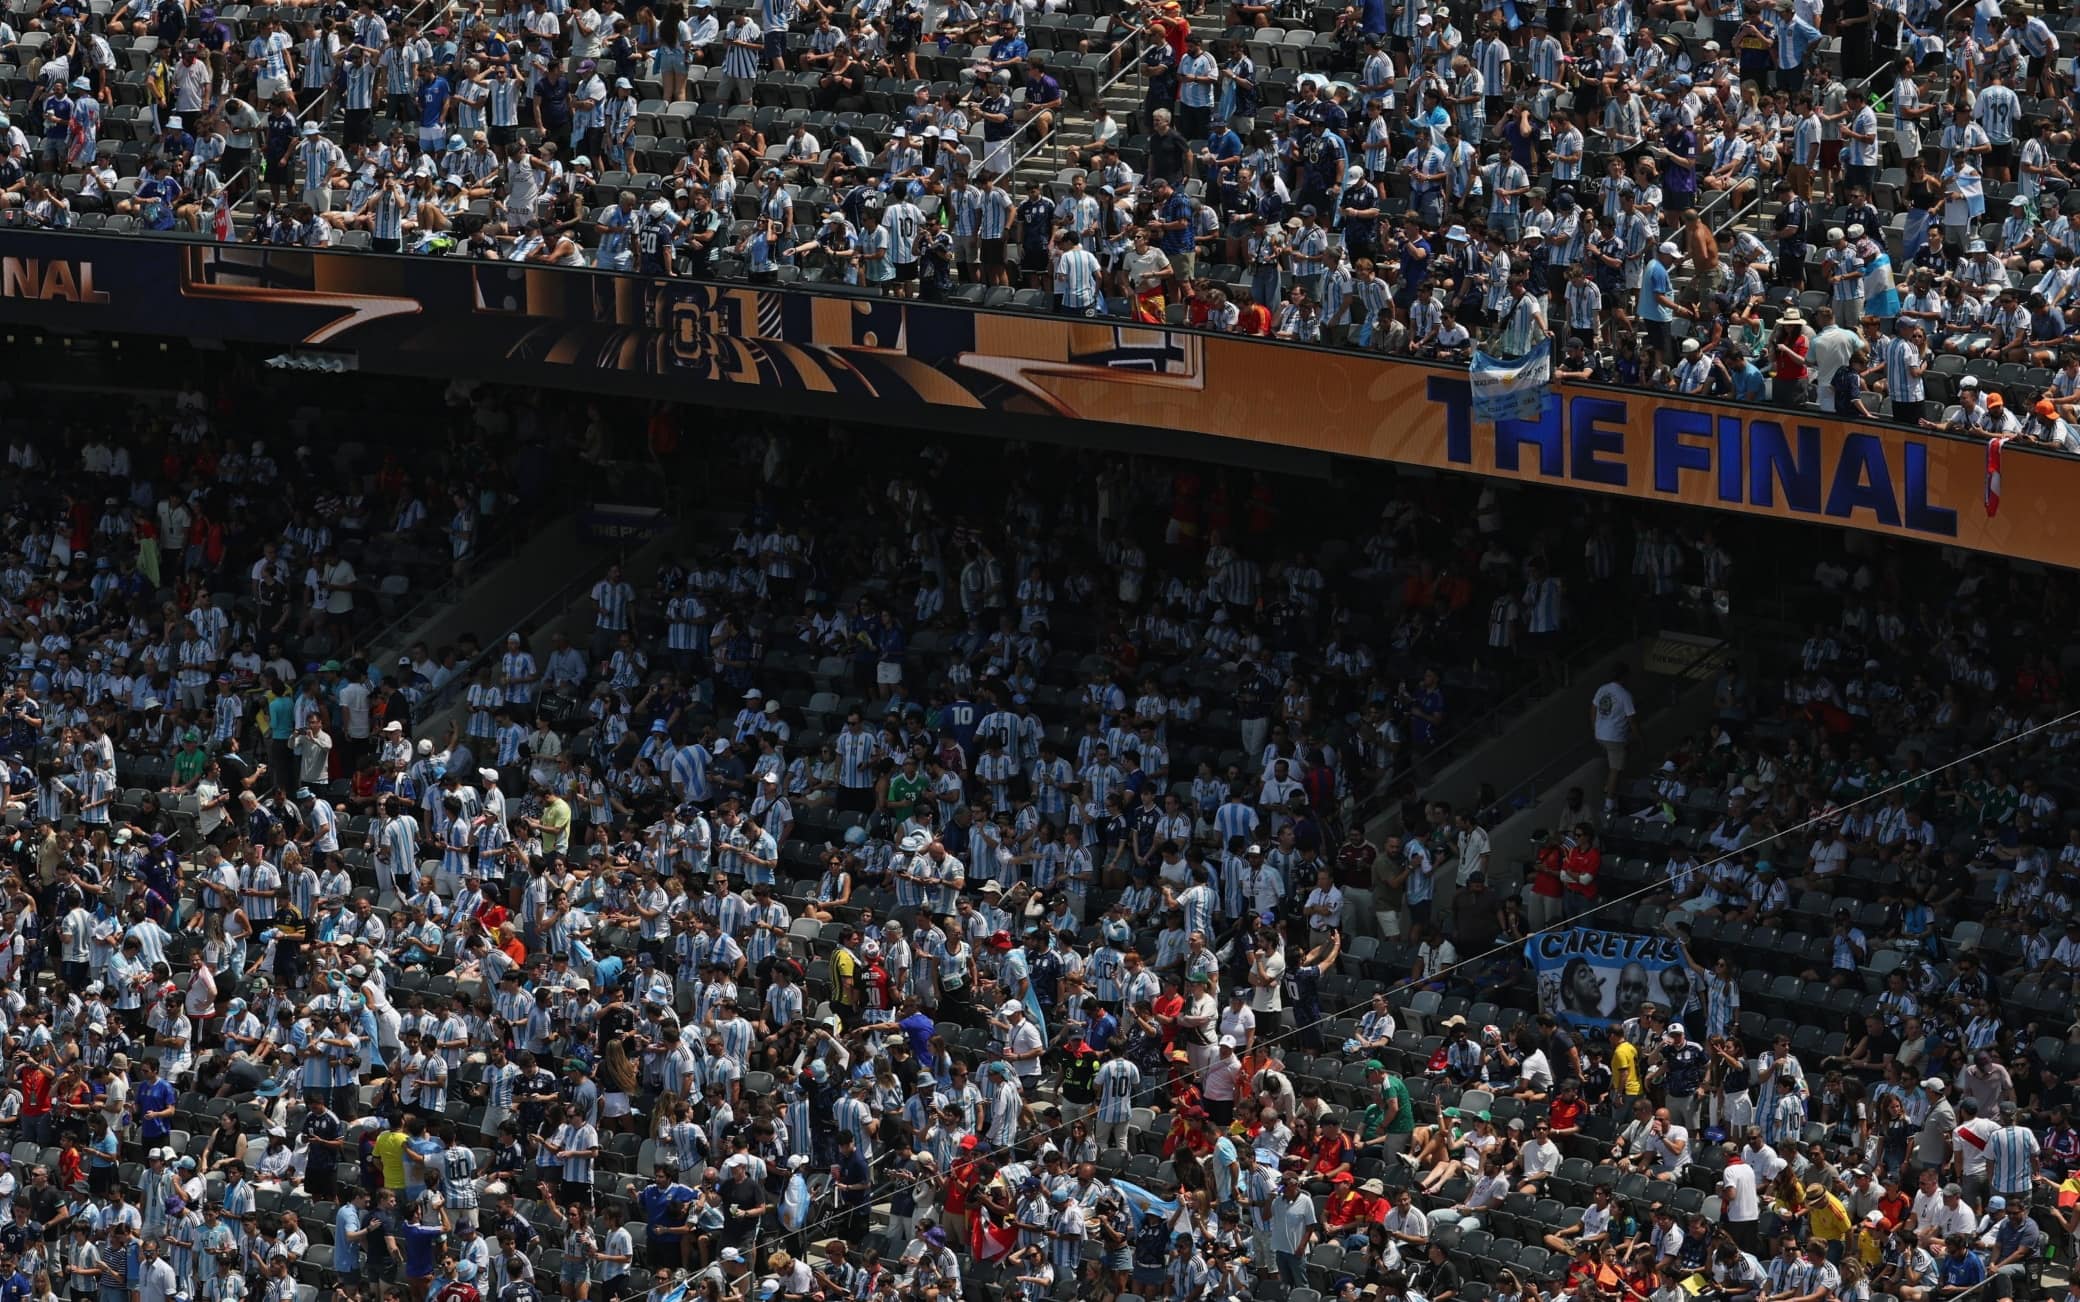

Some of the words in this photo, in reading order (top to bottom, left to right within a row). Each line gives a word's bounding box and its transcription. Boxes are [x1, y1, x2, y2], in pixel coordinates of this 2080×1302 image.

[425, 94, 434, 103] 10
[1990, 103, 2009, 124] 19
[899, 217, 914, 237] 10
[641, 231, 656, 254] 20
[0, 256, 109, 304] NAL
[1427, 376, 1627, 487] THE
[1653, 407, 1958, 538] FINAL
[951, 706, 974, 726] 10
[1540, 930, 1680, 962] CARETAS
[1098, 961, 1112, 979] 10
[866, 988, 881, 1008] 10
[1287, 980, 1300, 1001] 10
[1111, 1076, 1129, 1098] 10
[1789, 1112, 1800, 1131] 10
[447, 1158, 469, 1180] 10
[1948, 1272, 1957, 1283] 10
